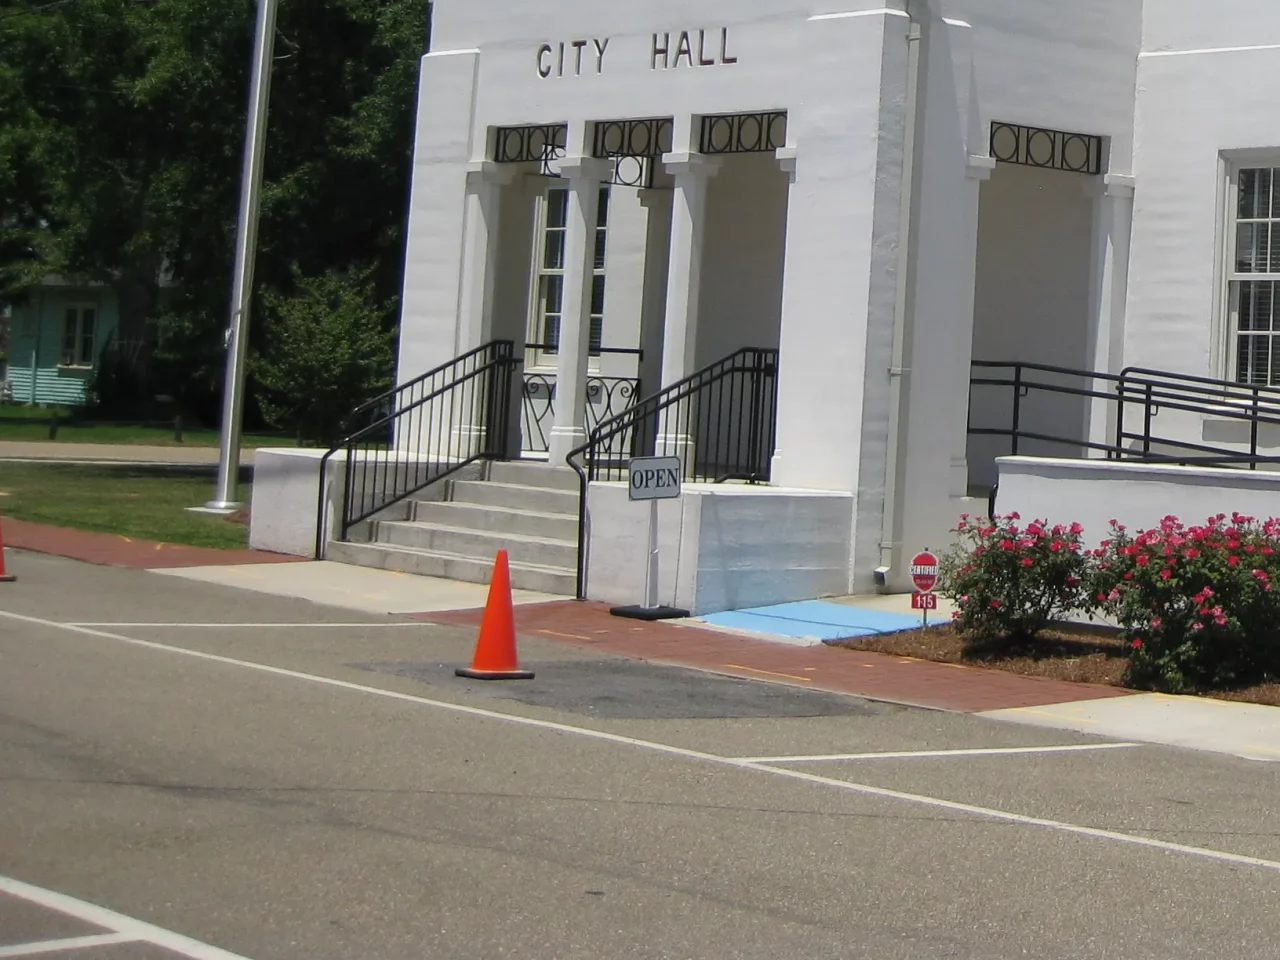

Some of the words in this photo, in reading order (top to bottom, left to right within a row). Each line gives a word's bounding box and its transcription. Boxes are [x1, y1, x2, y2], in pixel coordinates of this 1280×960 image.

[537, 38, 609, 79] CITY
[651, 27, 737, 70] HALL
[632, 468, 679, 489] OPEN
[909, 565, 939, 575] CERTIFIED
